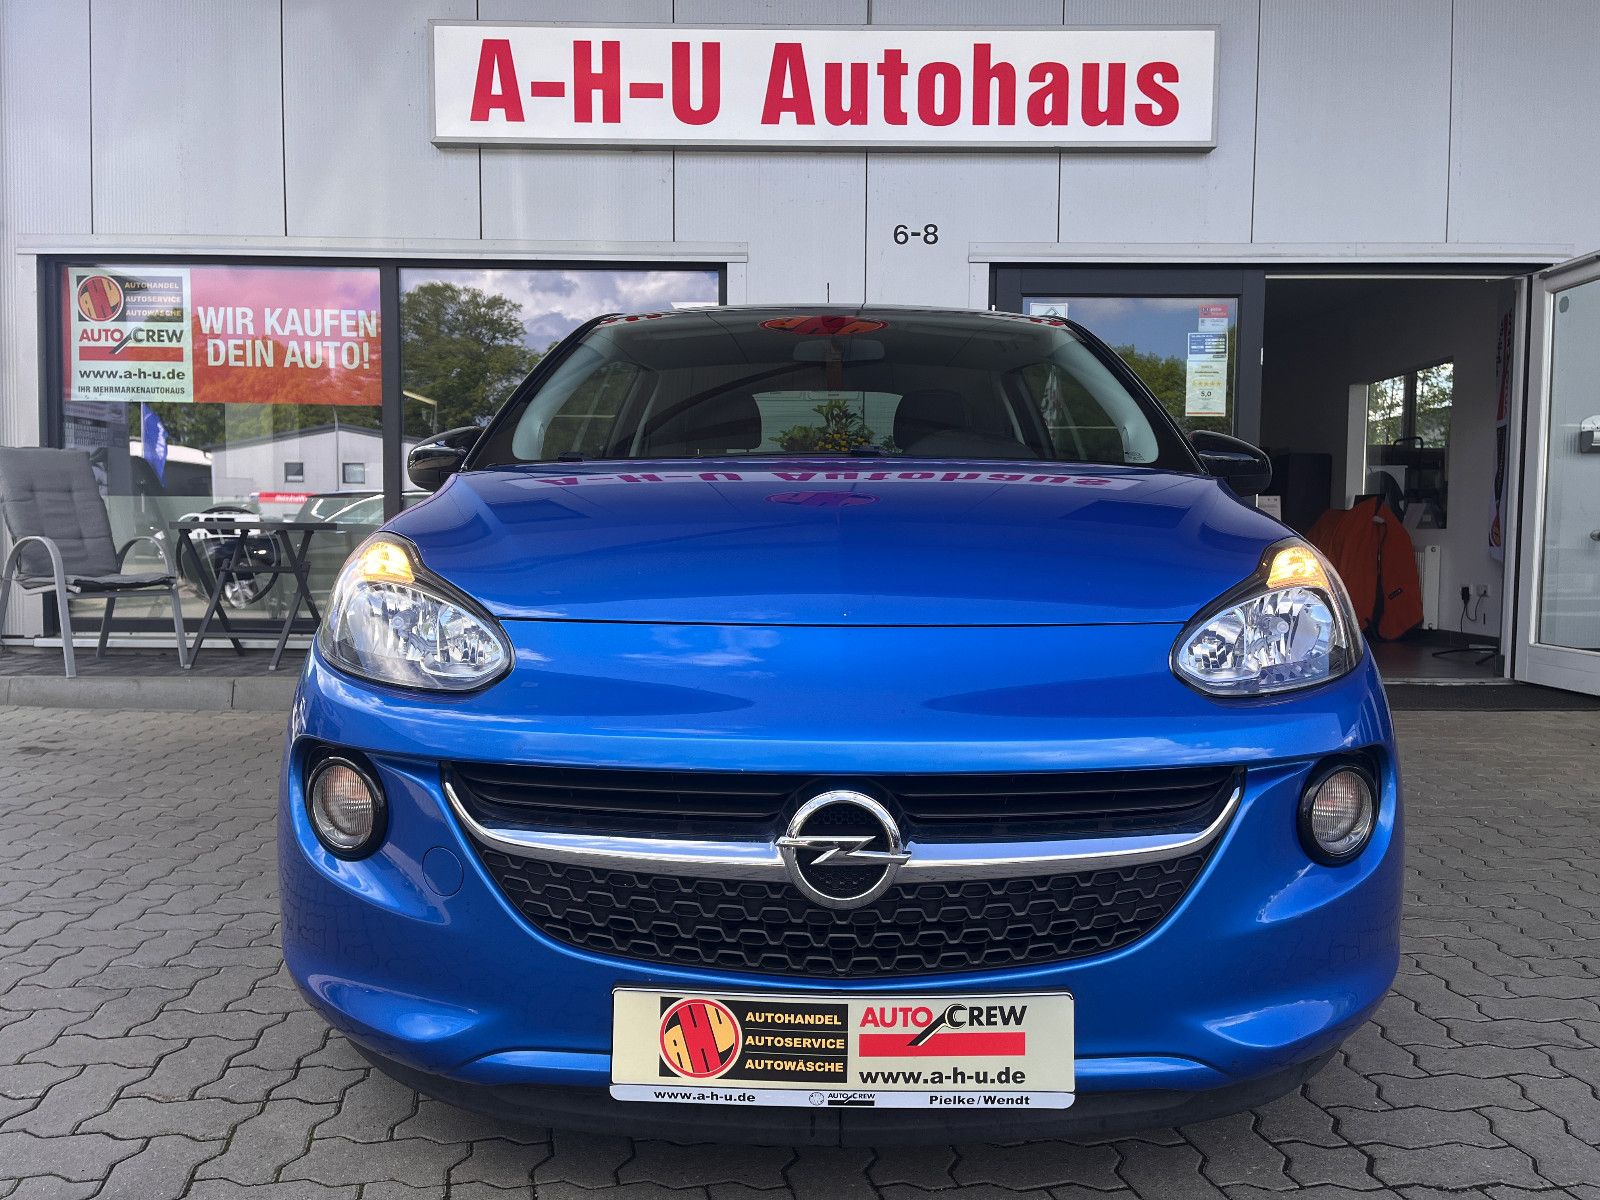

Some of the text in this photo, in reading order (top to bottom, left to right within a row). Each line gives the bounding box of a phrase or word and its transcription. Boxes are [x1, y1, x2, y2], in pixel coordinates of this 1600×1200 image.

[469, 38, 1180, 127] A-H-U Autohaus
[892, 224, 938, 246] 6-8
[124, 281, 179, 289] AUTOHANDEL
[125, 295, 182, 303] AUTOSERVICE
[197, 306, 377, 337] WIR KAUFEN
[79, 328, 183, 342] AUTO CREW
[206, 338, 370, 369] DEIN AUTO!
[79, 368, 185, 380] www.a-h-u.de
[93, 386, 185, 395] MEHRMARKENAUTOHAUS
[745, 1012, 842, 1025] AUTOHANDEL
[859, 1004, 1028, 1028] AUTO CREW
[745, 1035, 845, 1049] AUTOSERVICE
[745, 1059, 844, 1073] AUTOWÄSCHE
[859, 1067, 1026, 1085] www.a-h-u.de
[654, 1090, 756, 1102] www.a-h-u.de
[929, 1095, 1030, 1106] Pielke/Wendt
